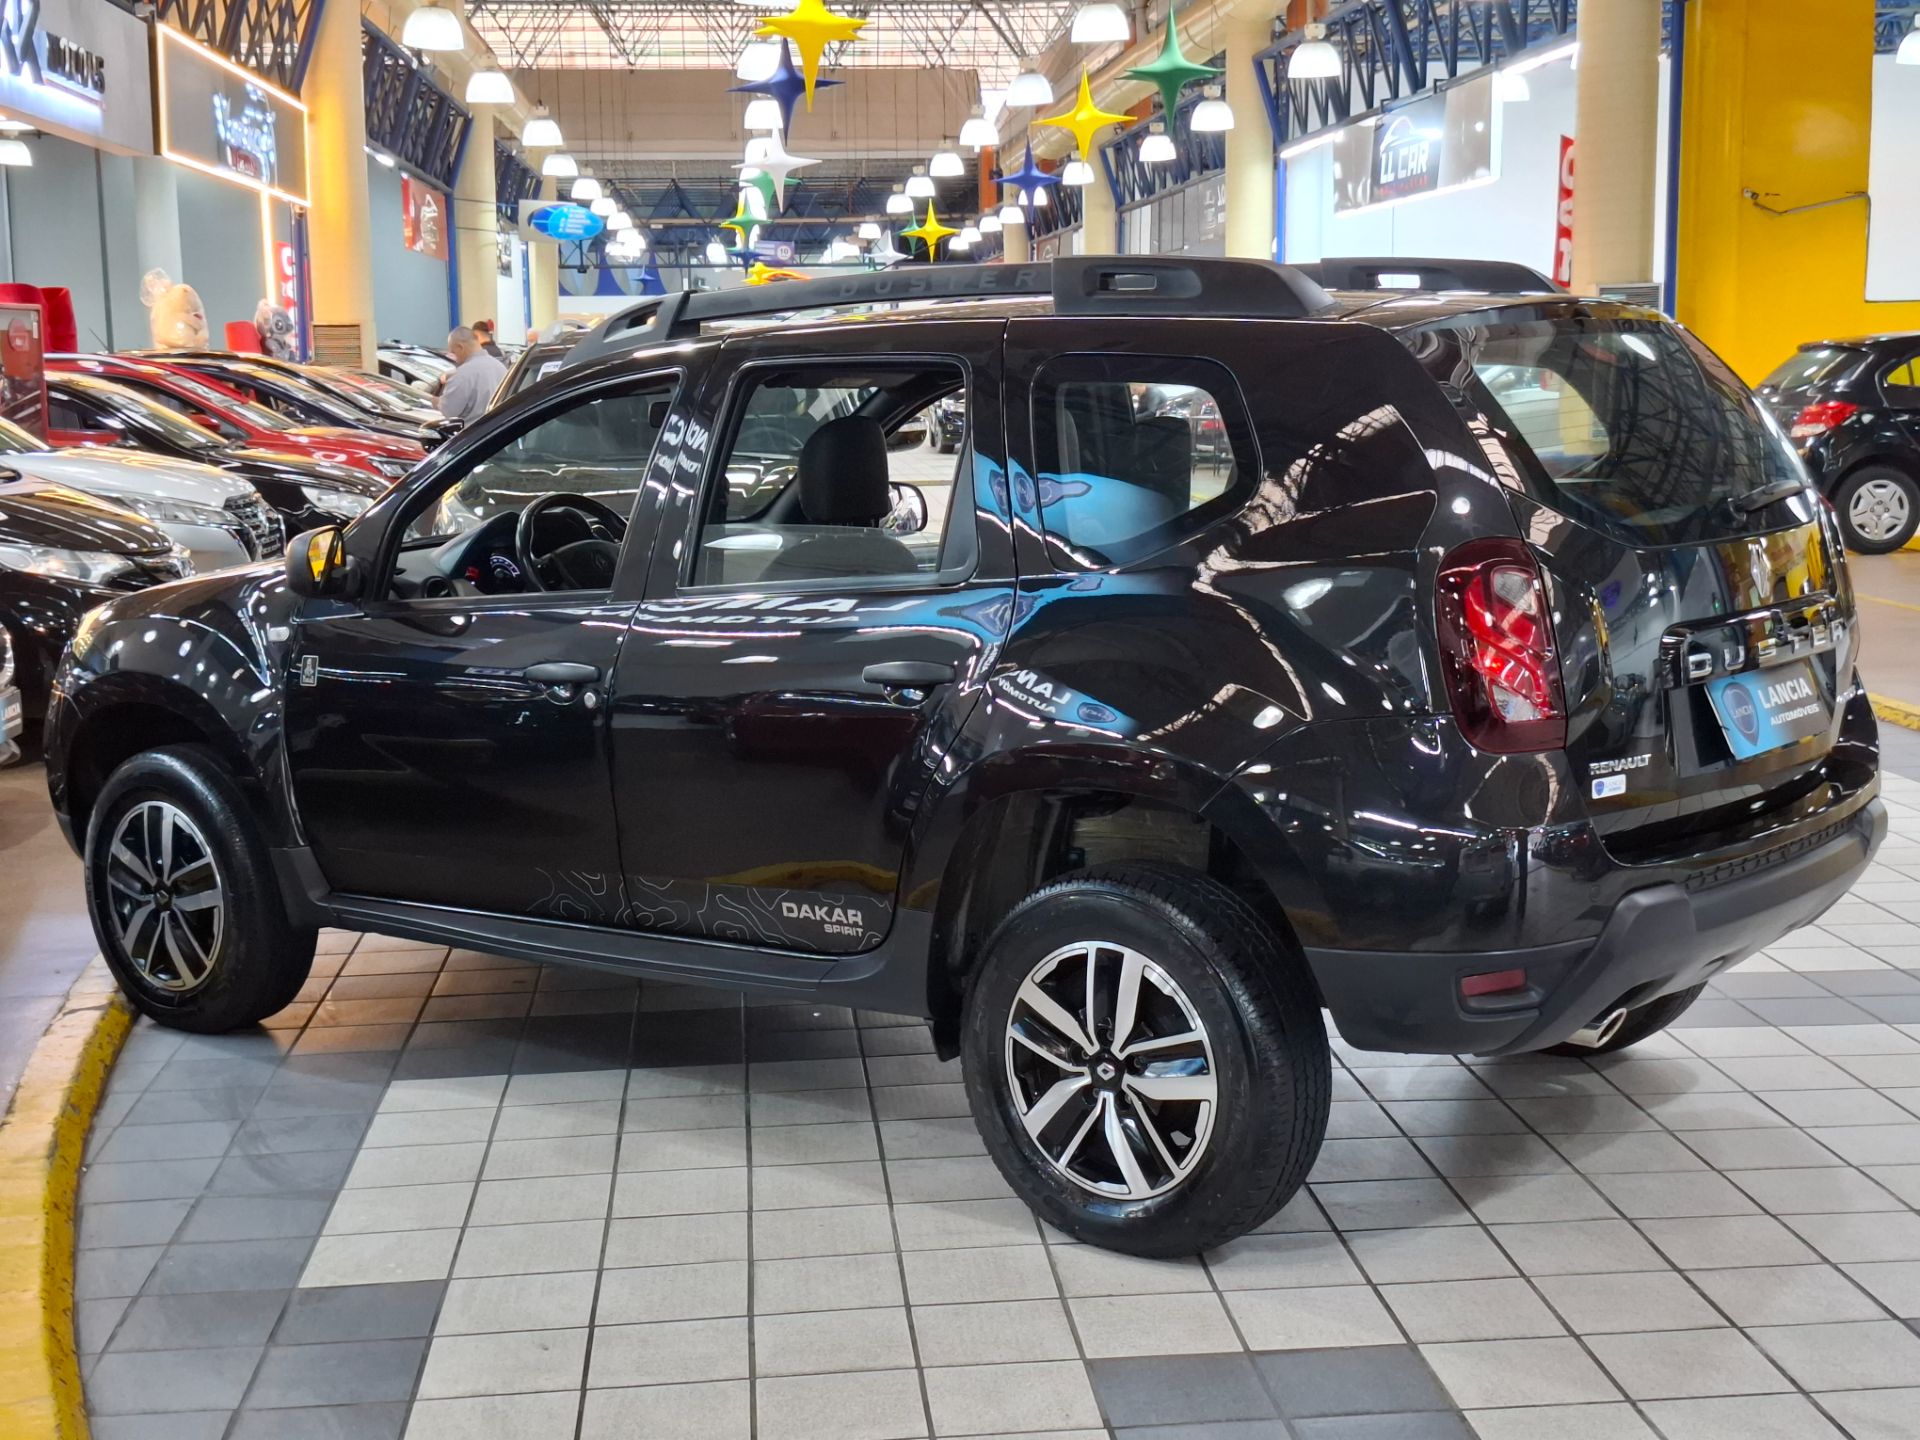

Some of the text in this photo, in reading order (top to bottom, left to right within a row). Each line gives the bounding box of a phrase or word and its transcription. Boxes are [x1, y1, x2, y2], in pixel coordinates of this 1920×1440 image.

[1397, 141, 1429, 179] CAR
[839, 268, 1038, 297] DUSTER
[1688, 617, 1845, 679] DUSTER
[1757, 677, 1813, 709] LANCIA
[1589, 753, 1652, 775] RENAULT
[781, 901, 863, 926] DAKAR
[823, 923, 864, 937] SPIRIT
